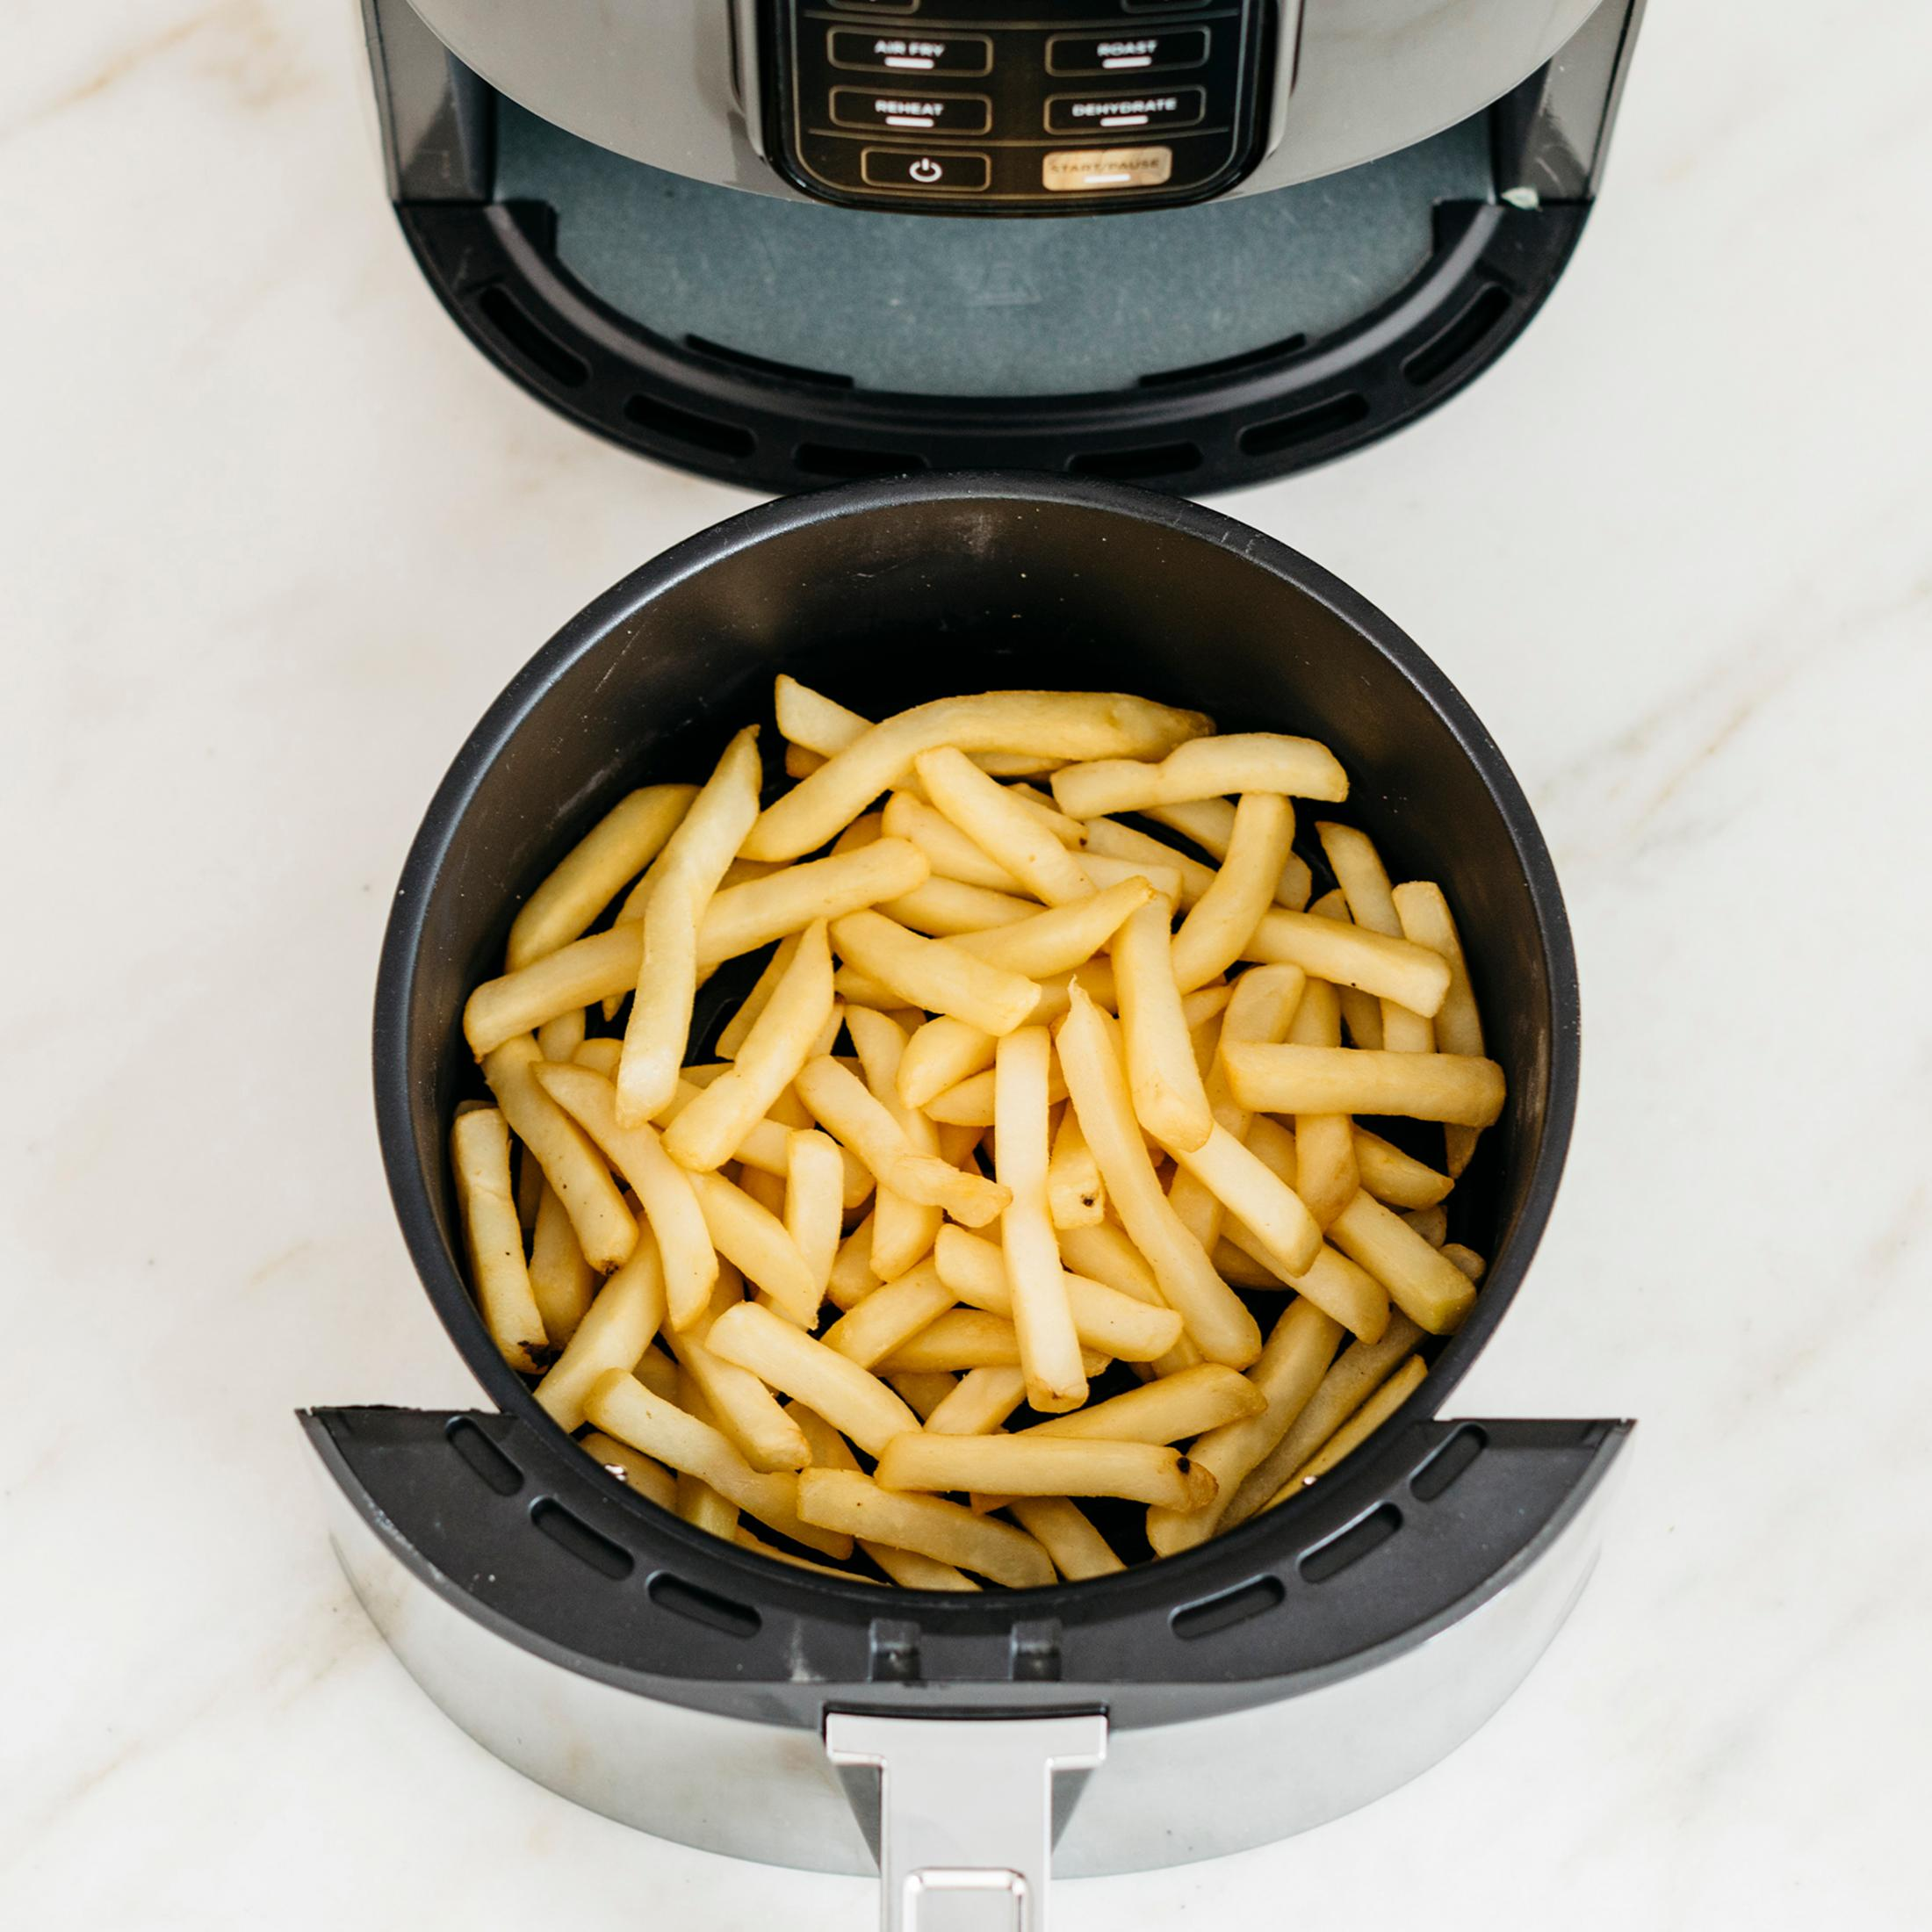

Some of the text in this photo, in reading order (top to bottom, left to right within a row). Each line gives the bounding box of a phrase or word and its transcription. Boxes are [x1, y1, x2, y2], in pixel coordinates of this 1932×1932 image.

[874, 40, 946, 57] AIR FRY
[1097, 40, 1157, 57] ROAST
[875, 99, 943, 116] REHEAT
[1072, 97, 1177, 117] DEHYDRATE
